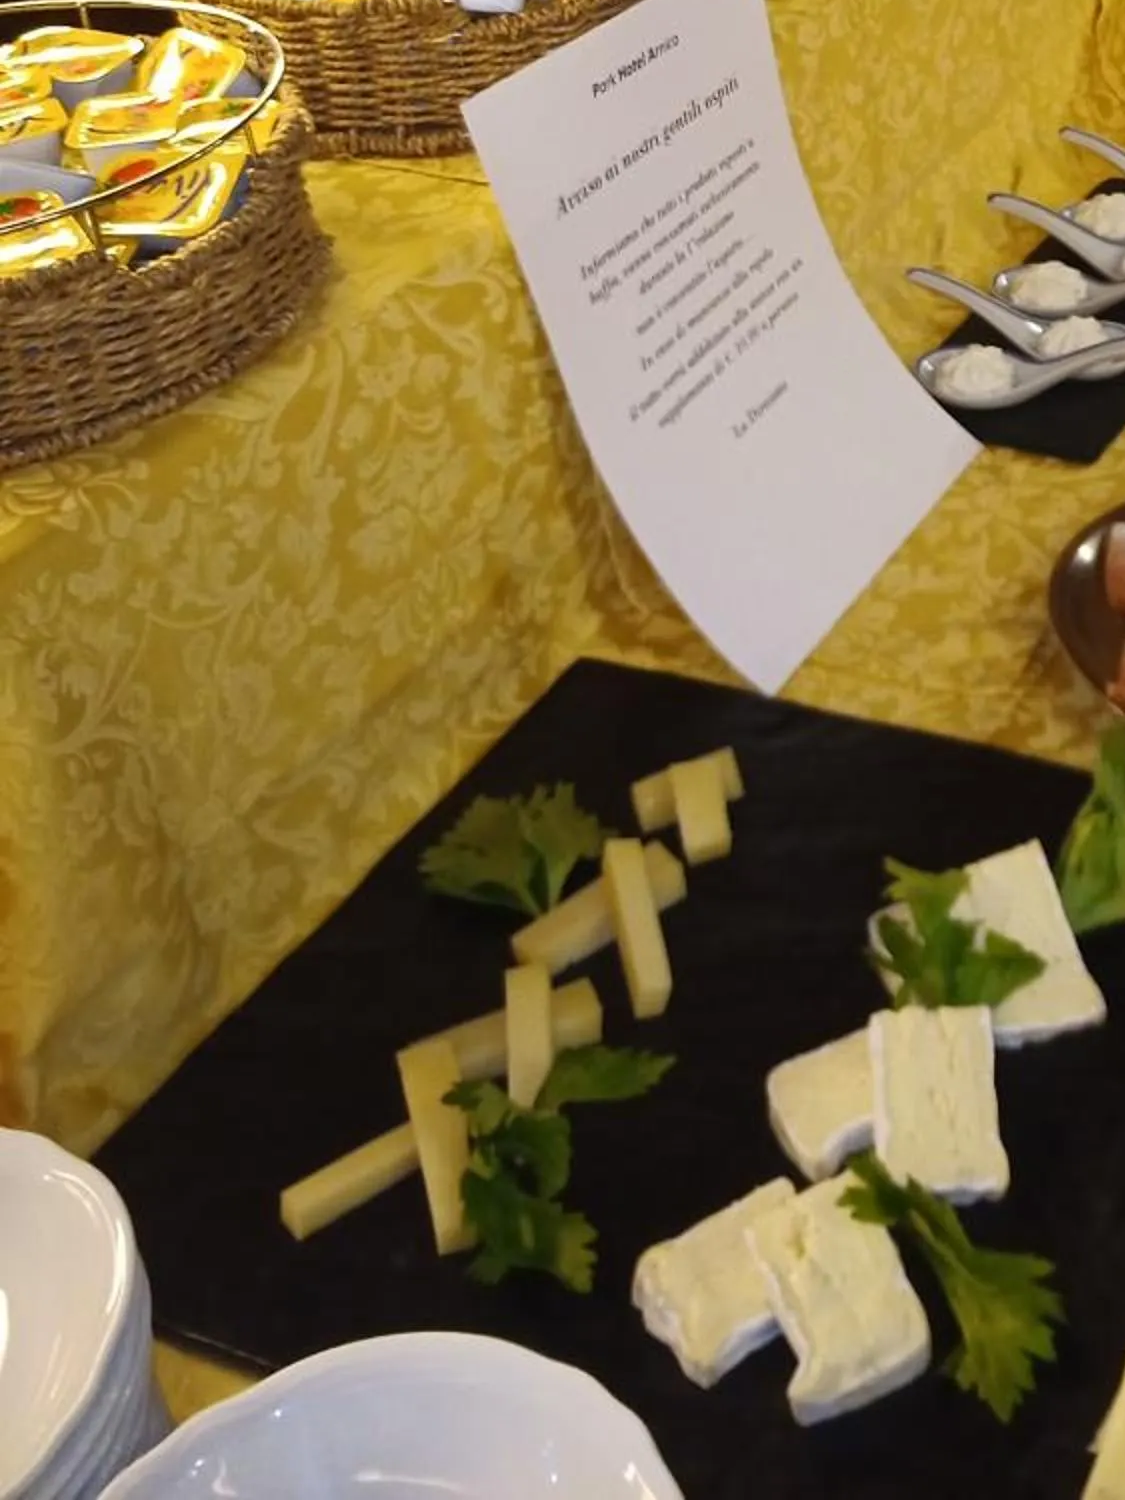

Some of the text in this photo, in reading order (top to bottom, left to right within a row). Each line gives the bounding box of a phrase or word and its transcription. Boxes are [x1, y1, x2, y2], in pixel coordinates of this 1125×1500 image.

[592, 74, 617, 98] Park
[617, 52, 646, 81] Hotel
[557, 176, 602, 220] Avviso
[622, 134, 660, 169] nostri
[662, 99, 703, 146] gentili
[704, 76, 739, 108] ospiti
